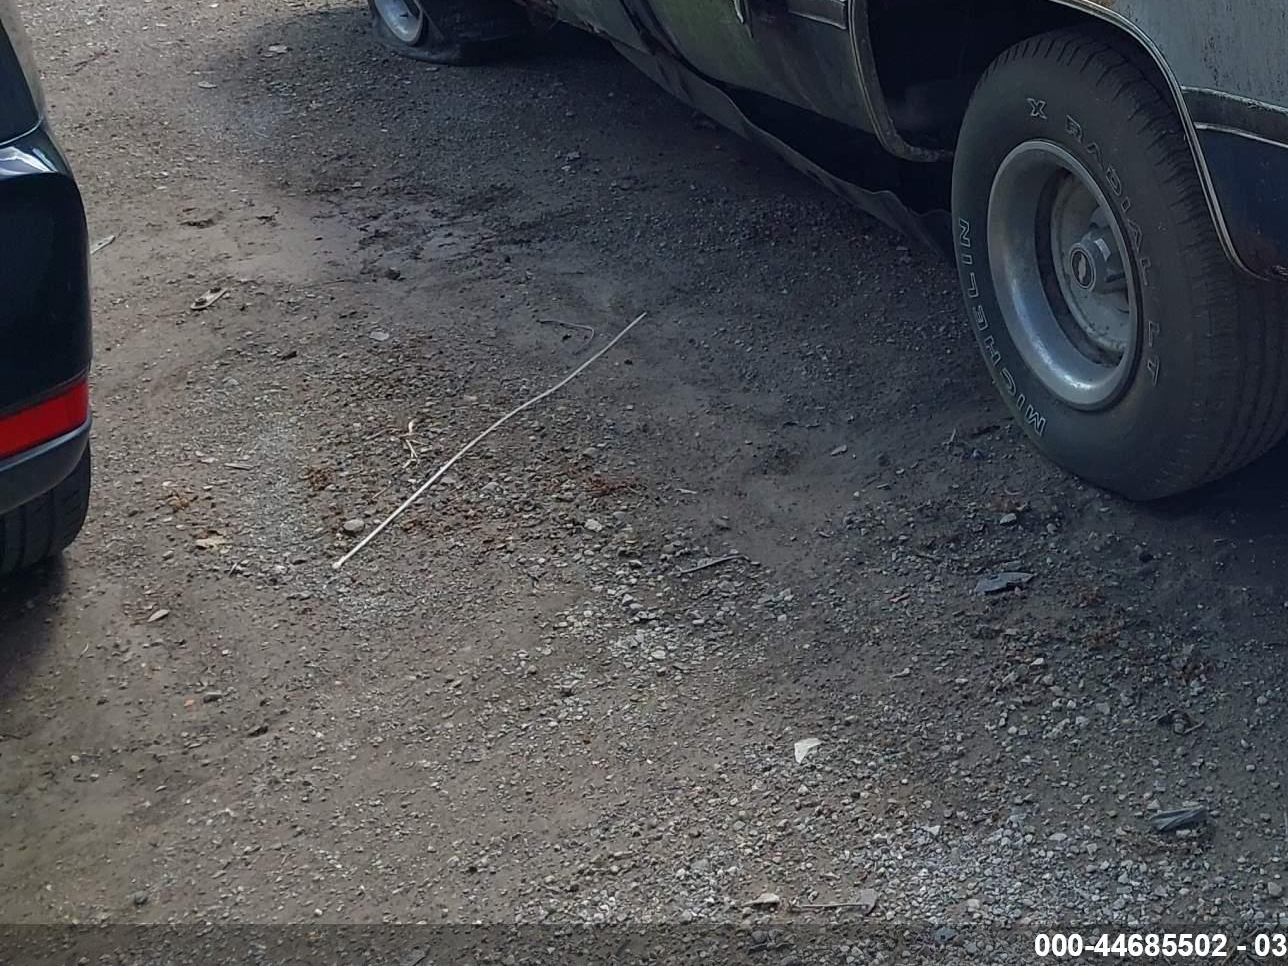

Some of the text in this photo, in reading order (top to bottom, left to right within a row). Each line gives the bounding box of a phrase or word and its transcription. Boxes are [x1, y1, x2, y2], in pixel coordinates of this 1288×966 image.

[957, 216, 1047, 437] MICHELIN
[1026, 97, 1162, 387] X RADIAL LT
